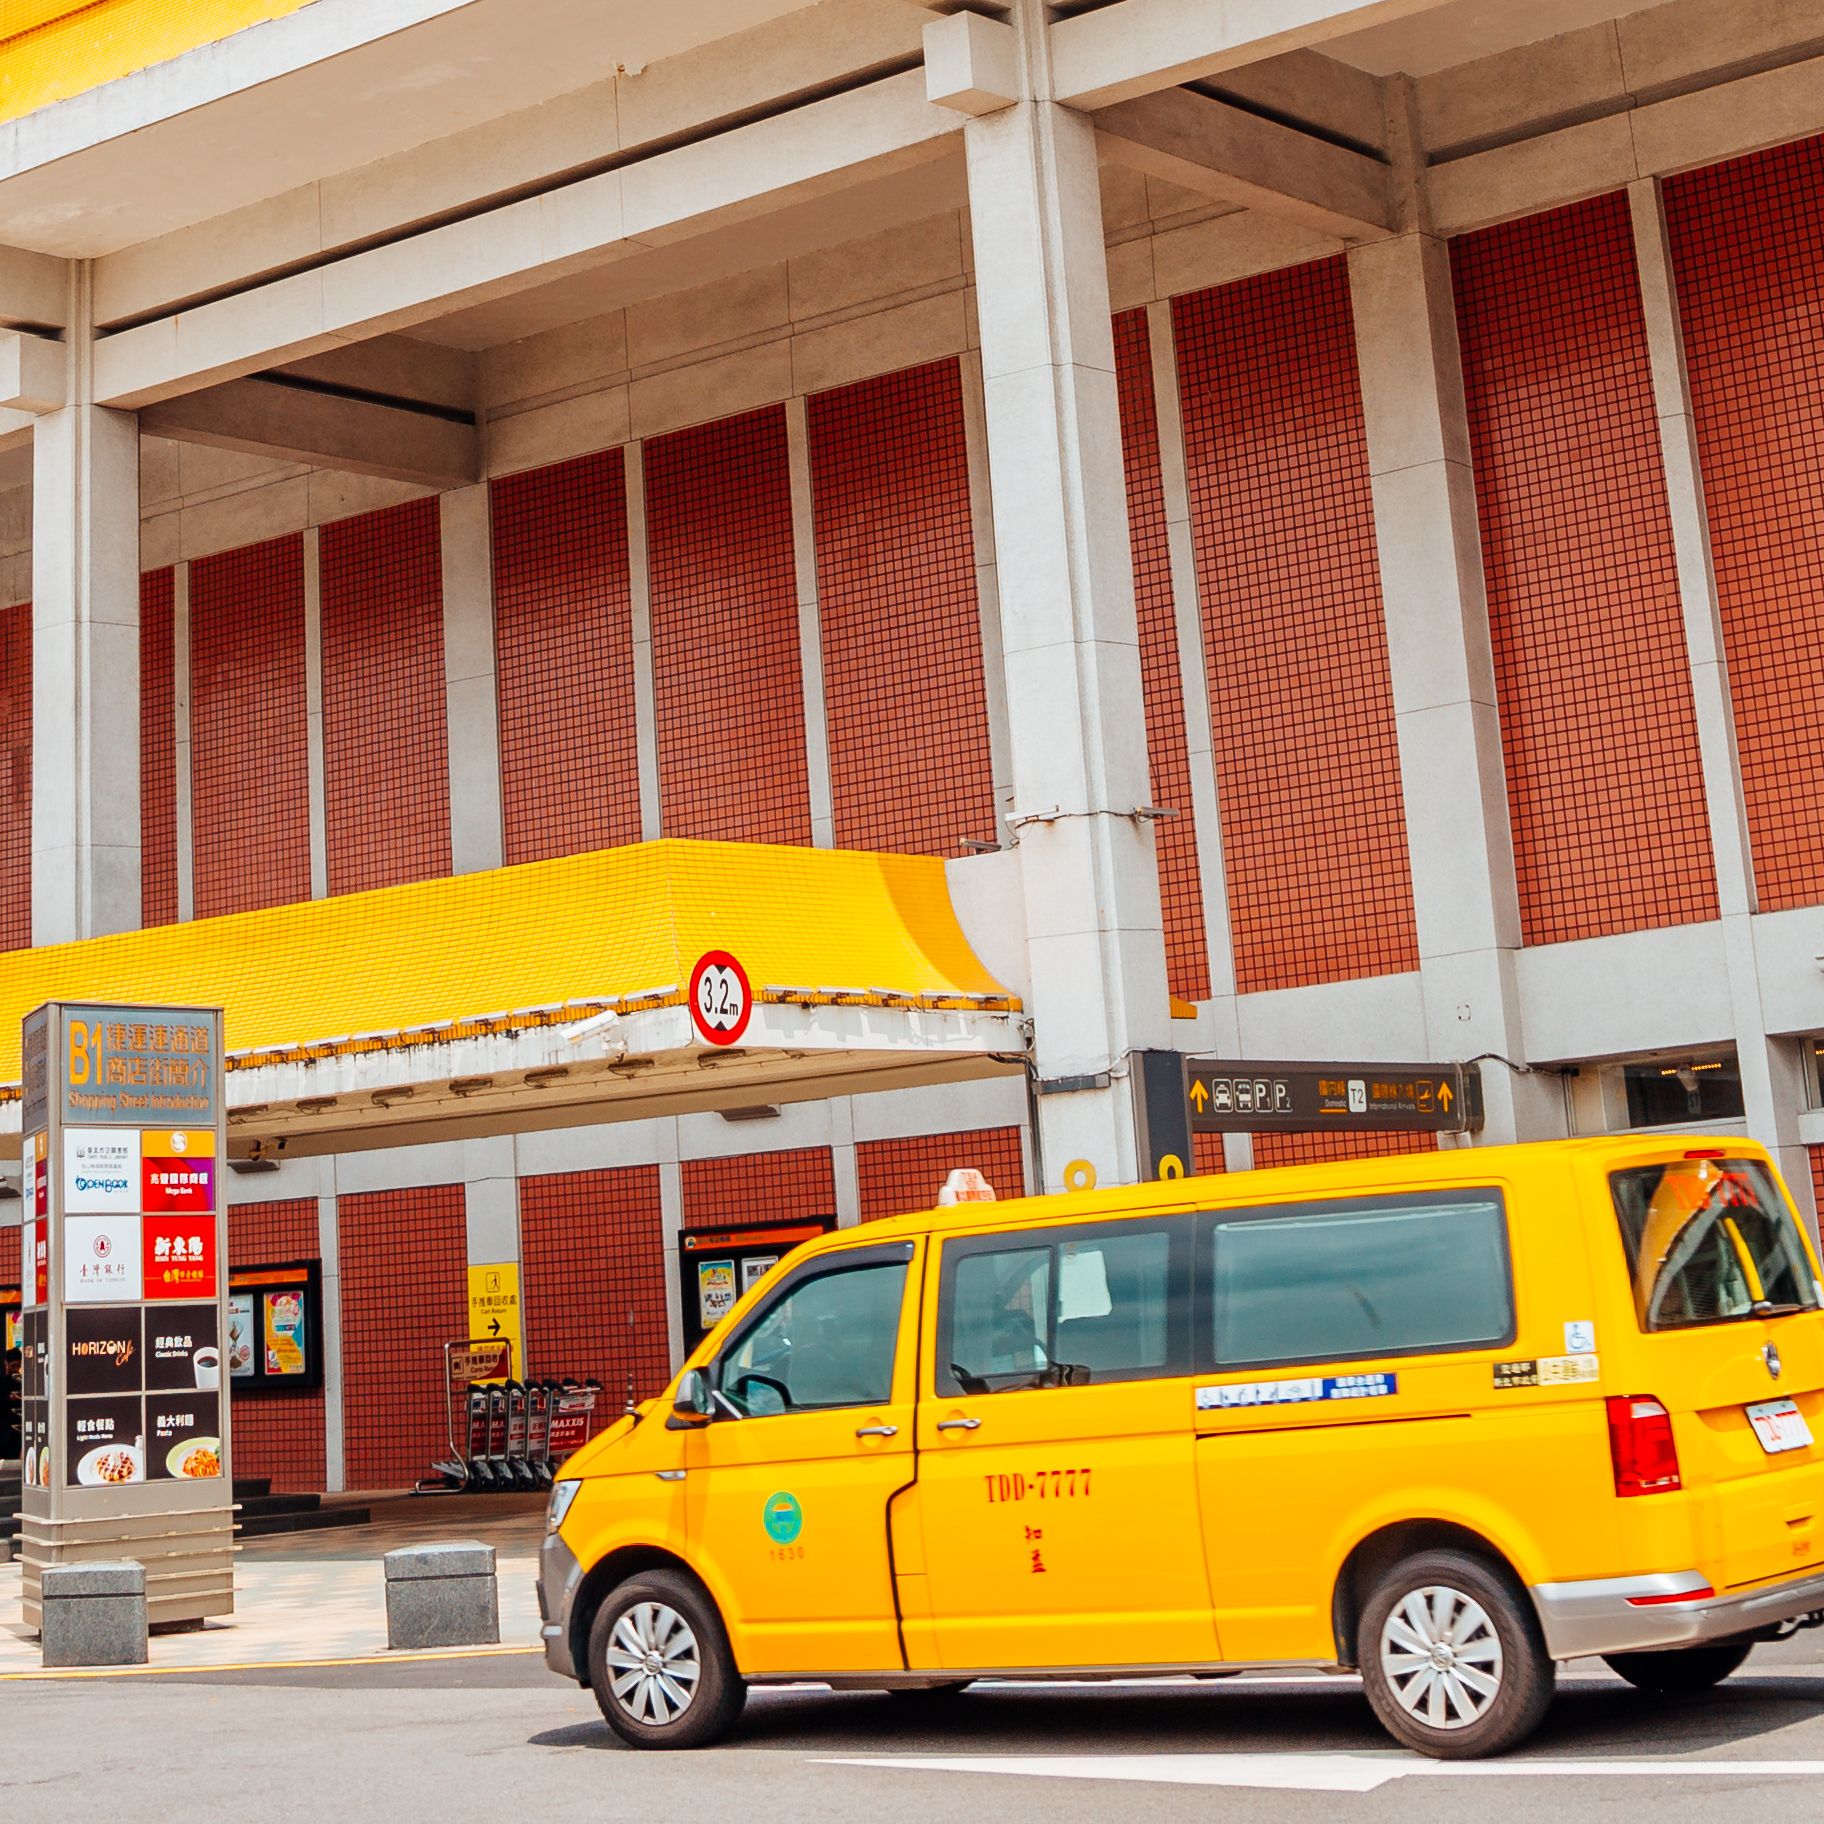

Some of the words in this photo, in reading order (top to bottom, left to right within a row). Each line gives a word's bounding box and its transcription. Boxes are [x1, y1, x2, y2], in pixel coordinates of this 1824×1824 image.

[106, 1023, 210, 1054] 捷運連通道
[69, 1020, 103, 1085] B1
[107, 1056, 210, 1088] 商店街簡介
[68, 1089, 116, 1112] Shopping
[1350, 1089, 1364, 1104] T2
[155, 1236, 203, 1255] 新東陽
[72, 1340, 126, 1356] HORIZON
[551, 1418, 584, 1427] MAXXIS
